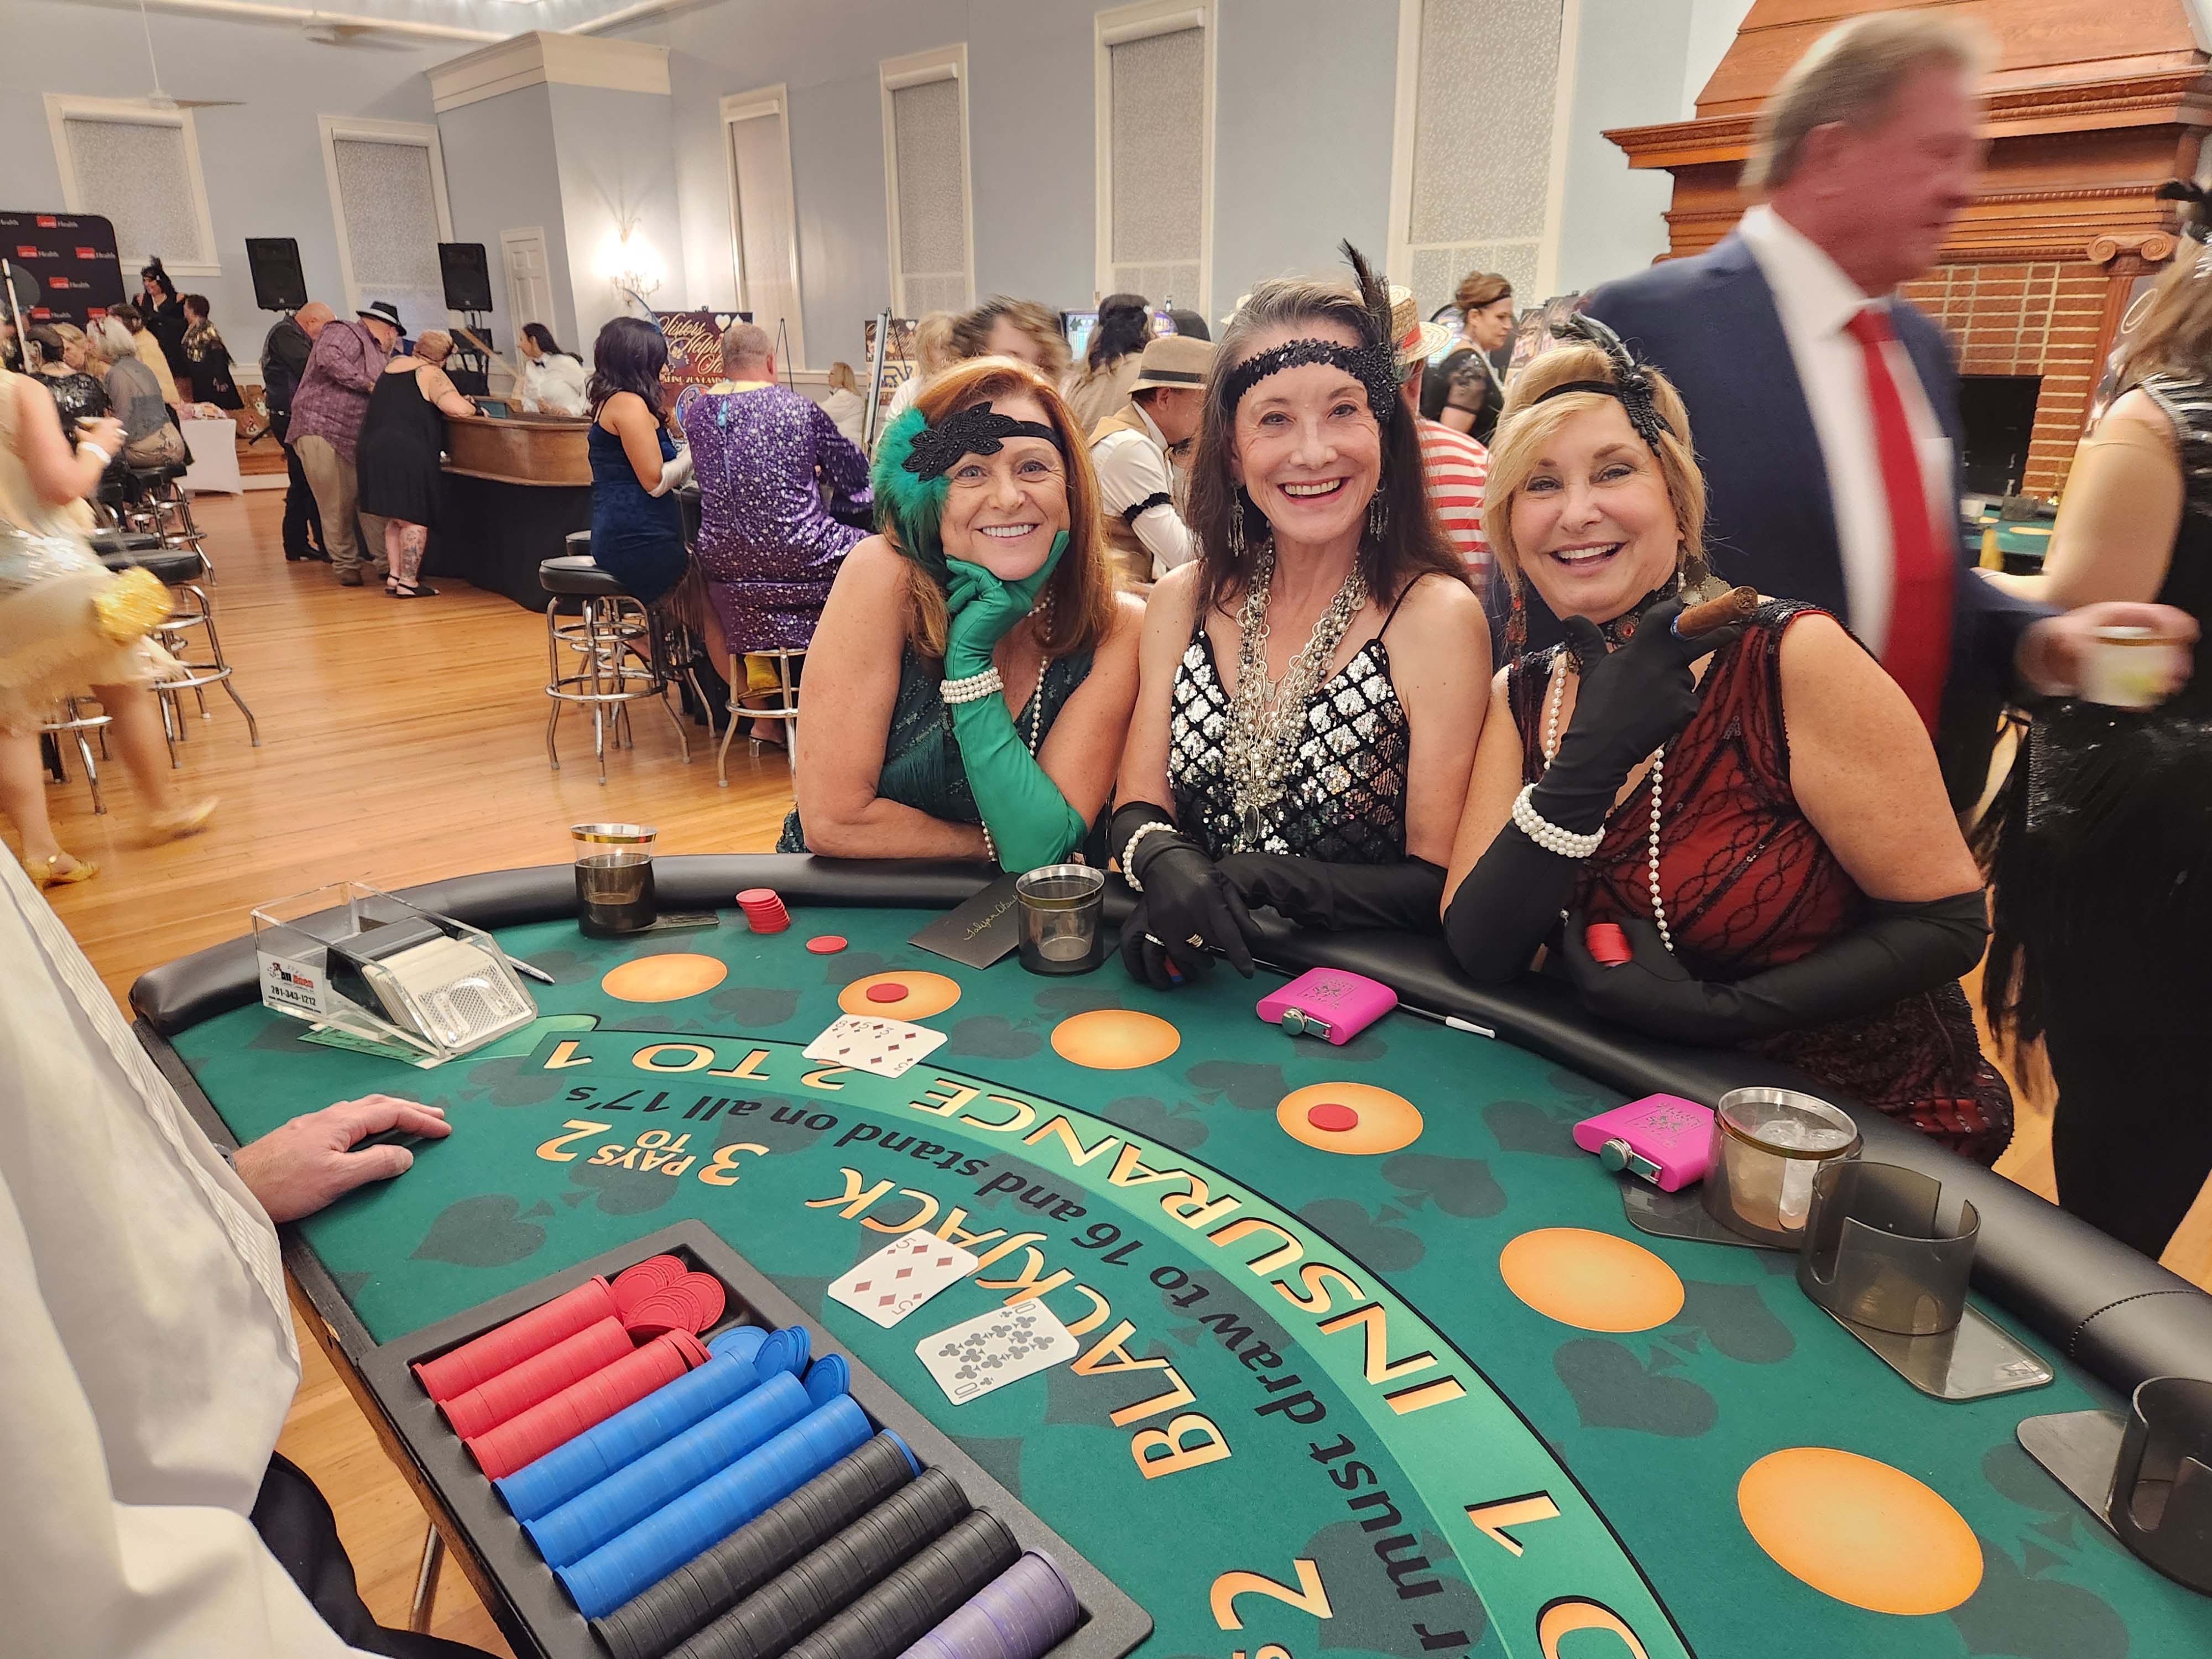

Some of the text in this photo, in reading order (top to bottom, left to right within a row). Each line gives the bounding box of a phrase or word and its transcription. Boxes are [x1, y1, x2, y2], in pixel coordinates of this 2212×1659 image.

[543, 1039, 594, 1070] 1
[632, 1042, 771, 1081] TO
[535, 1119, 771, 1186] 3 PAYS TO 2
[896, 1238, 916, 1249] 5
[909, 1077, 1467, 1416] INSURANCE
[805, 1166, 1233, 1480] BLACKJACK
[891, 1300, 913, 1315] 5
[1012, 1300, 1036, 1314] 10
[565, 1086, 1443, 1600] must draw to 16 and stand on all 17's
[954, 1381, 981, 1399] 10
[1464, 1490, 1561, 1557] 1
[1210, 1557, 1334, 1631] 2
